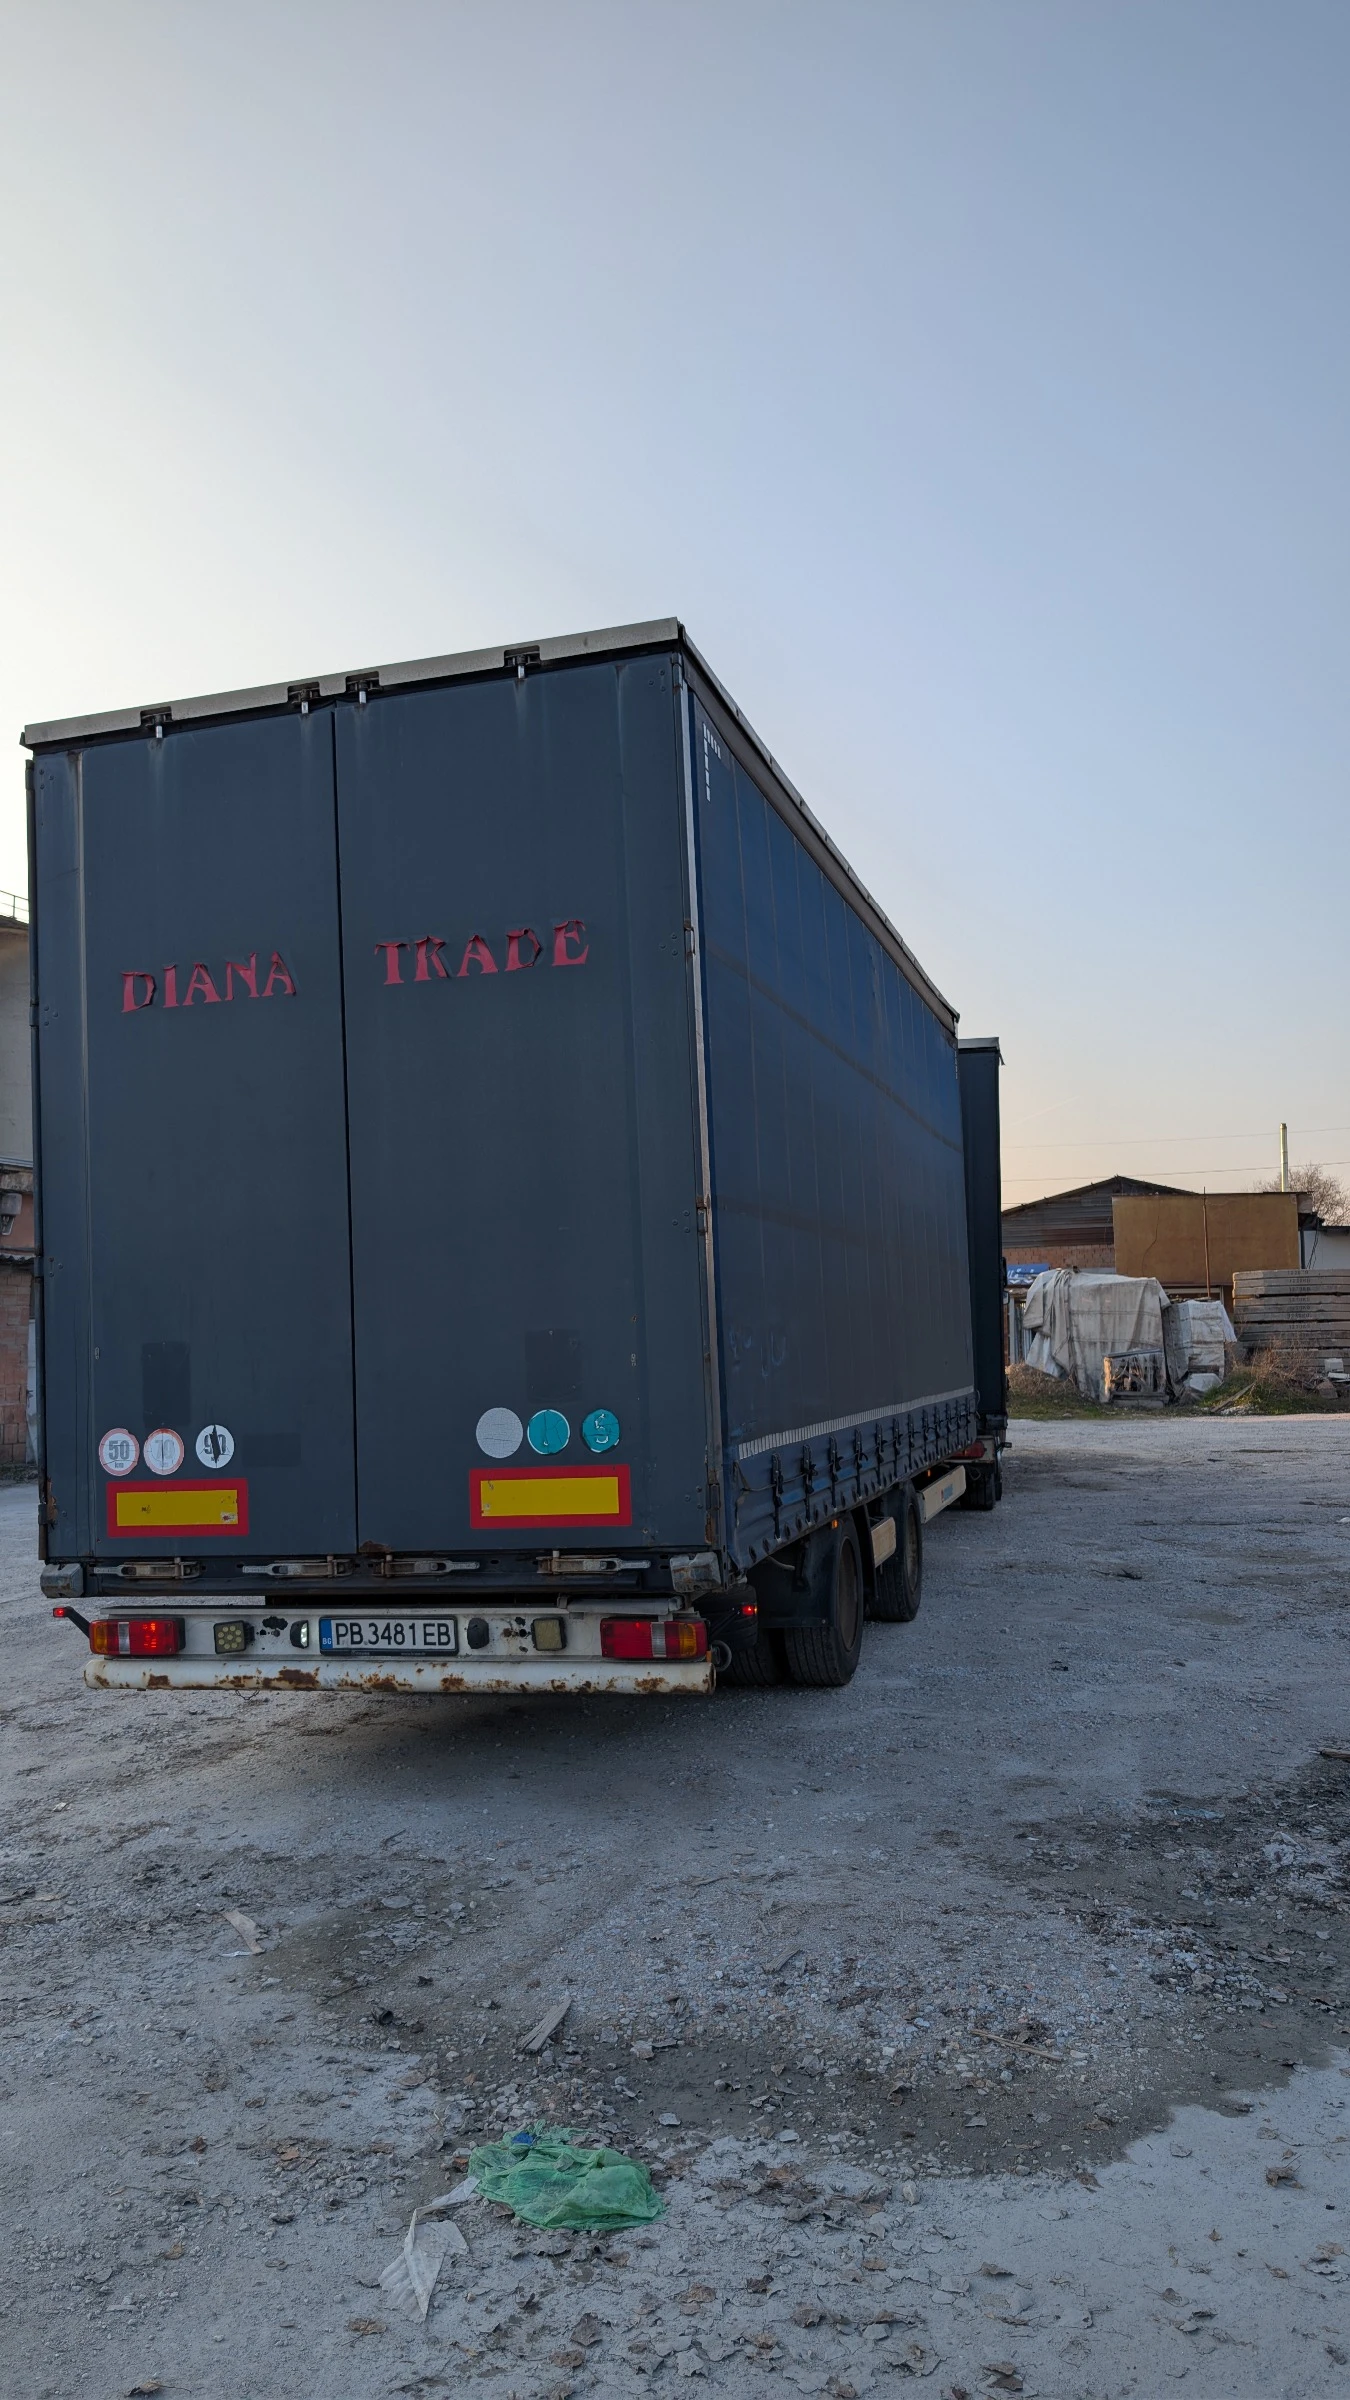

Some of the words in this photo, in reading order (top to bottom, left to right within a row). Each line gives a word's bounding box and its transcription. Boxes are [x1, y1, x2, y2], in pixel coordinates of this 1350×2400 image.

[121, 951, 296, 1012] DIANA
[374, 919, 589, 985] TRADE
[108, 1440, 130, 1460] 50
[154, 1439, 176, 1460] 70
[322, 1637, 332, 1645] BG
